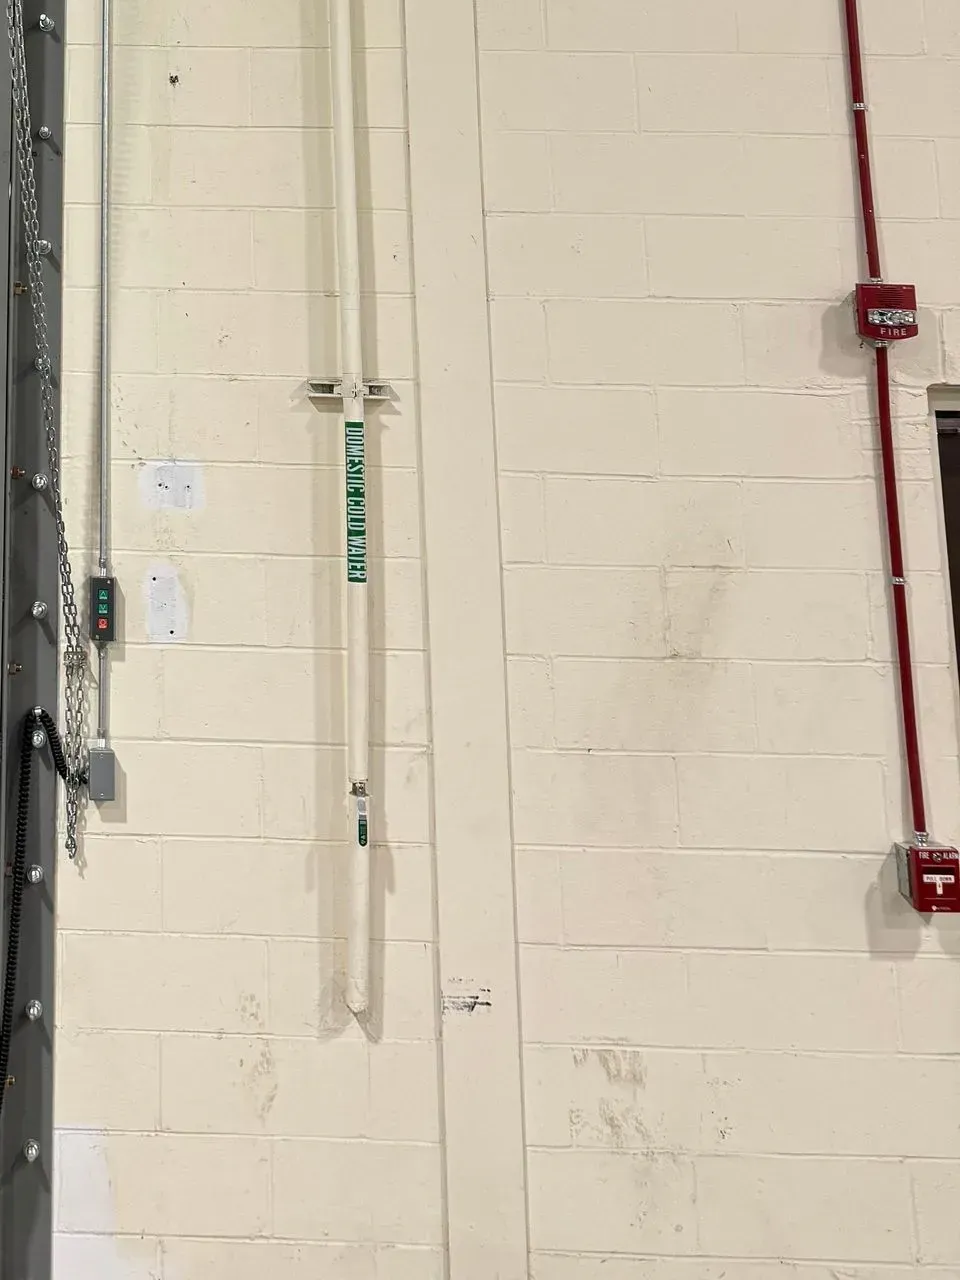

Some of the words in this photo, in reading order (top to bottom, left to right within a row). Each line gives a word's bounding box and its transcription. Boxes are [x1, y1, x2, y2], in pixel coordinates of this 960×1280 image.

[880, 328, 907, 336] FIRE
[346, 427, 365, 492] DOMESTIC
[347, 497, 366, 531] COLD
[348, 536, 367, 579] WATER
[919, 851, 930, 859] FIRE
